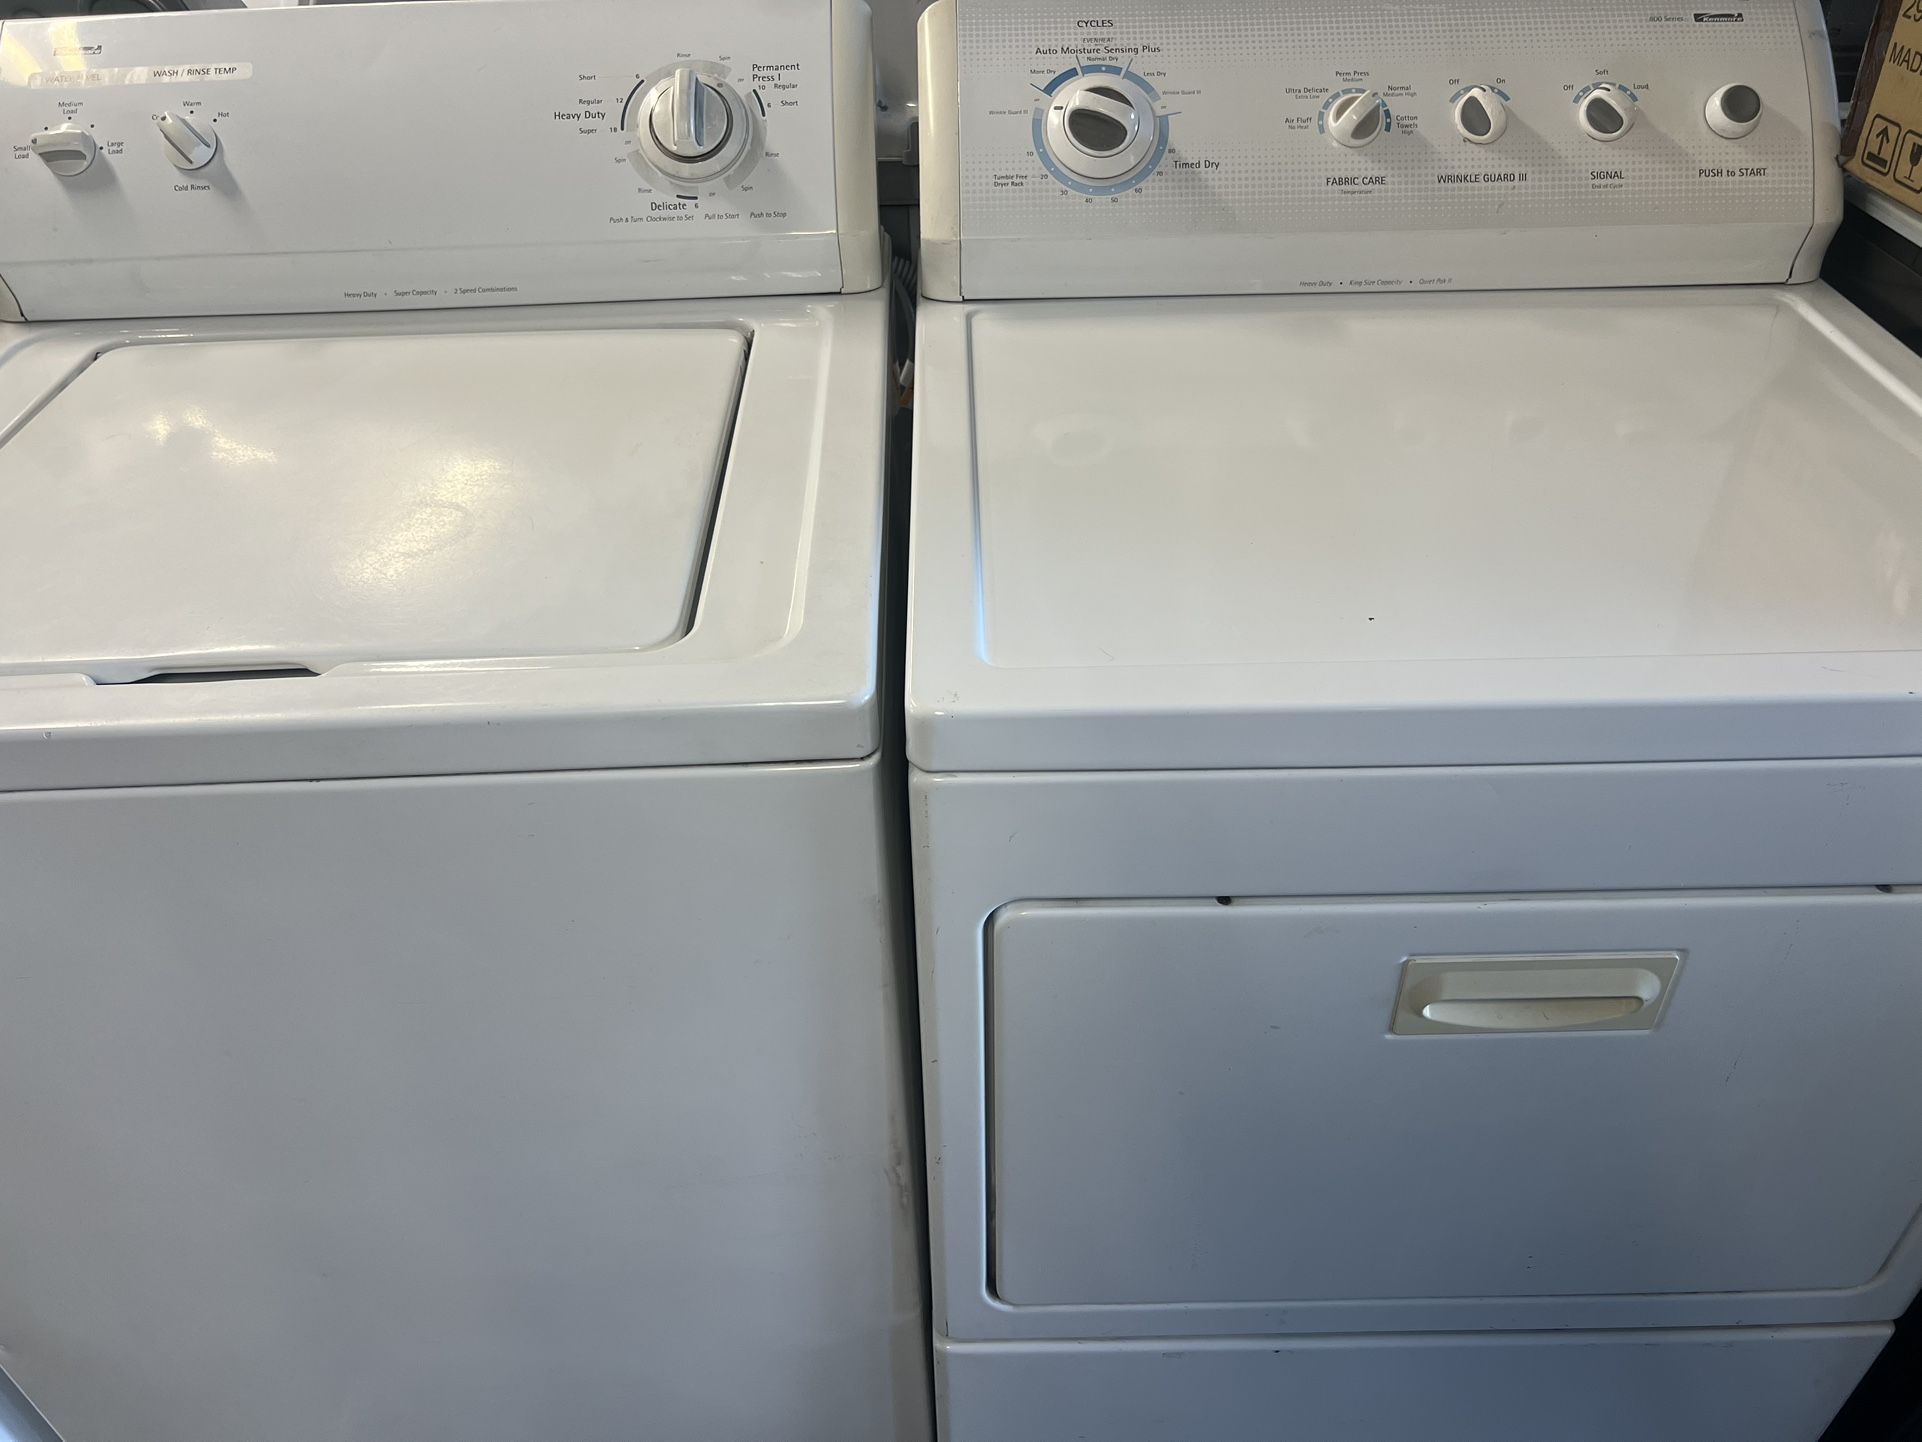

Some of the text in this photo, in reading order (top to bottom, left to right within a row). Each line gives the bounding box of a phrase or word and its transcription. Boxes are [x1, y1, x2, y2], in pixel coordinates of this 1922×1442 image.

[1077, 19, 1113, 28] CYCLES
[1035, 45, 1161, 55] Auto Moisture Sensing Plus
[1889, 42, 1922, 76] MAD
[153, 66, 237, 77] WASH / RINSE TEMP
[752, 62, 801, 72] Permanent
[752, 73, 775, 82] Press
[1448, 78, 1460, 86] Off
[773, 83, 799, 91] Regular
[578, 98, 603, 106] Regular
[554, 110, 606, 121] Heavy Duty
[578, 127, 597, 135] Super
[107, 140, 124, 148] Large
[1173, 160, 1220, 170] Timed Dry
[1590, 170, 1624, 180] SIGNAL
[1698, 168, 1767, 178] PUSH to START
[1326, 176, 1386, 186] FABRIC CARE
[1437, 173, 1527, 183] WRINKLE GUARD III
[173, 183, 211, 192] Cold Rinses
[741, 184, 753, 192] Spin
[650, 201, 687, 211] Delicate
[750, 211, 766, 219] Push
[609, 216, 623, 224] Push
[344, 291, 377, 299] Heavy Duty
[393, 288, 438, 297] Super Capacity
[459, 287, 477, 295] Speed
[477, 286, 518, 294] Combinations
